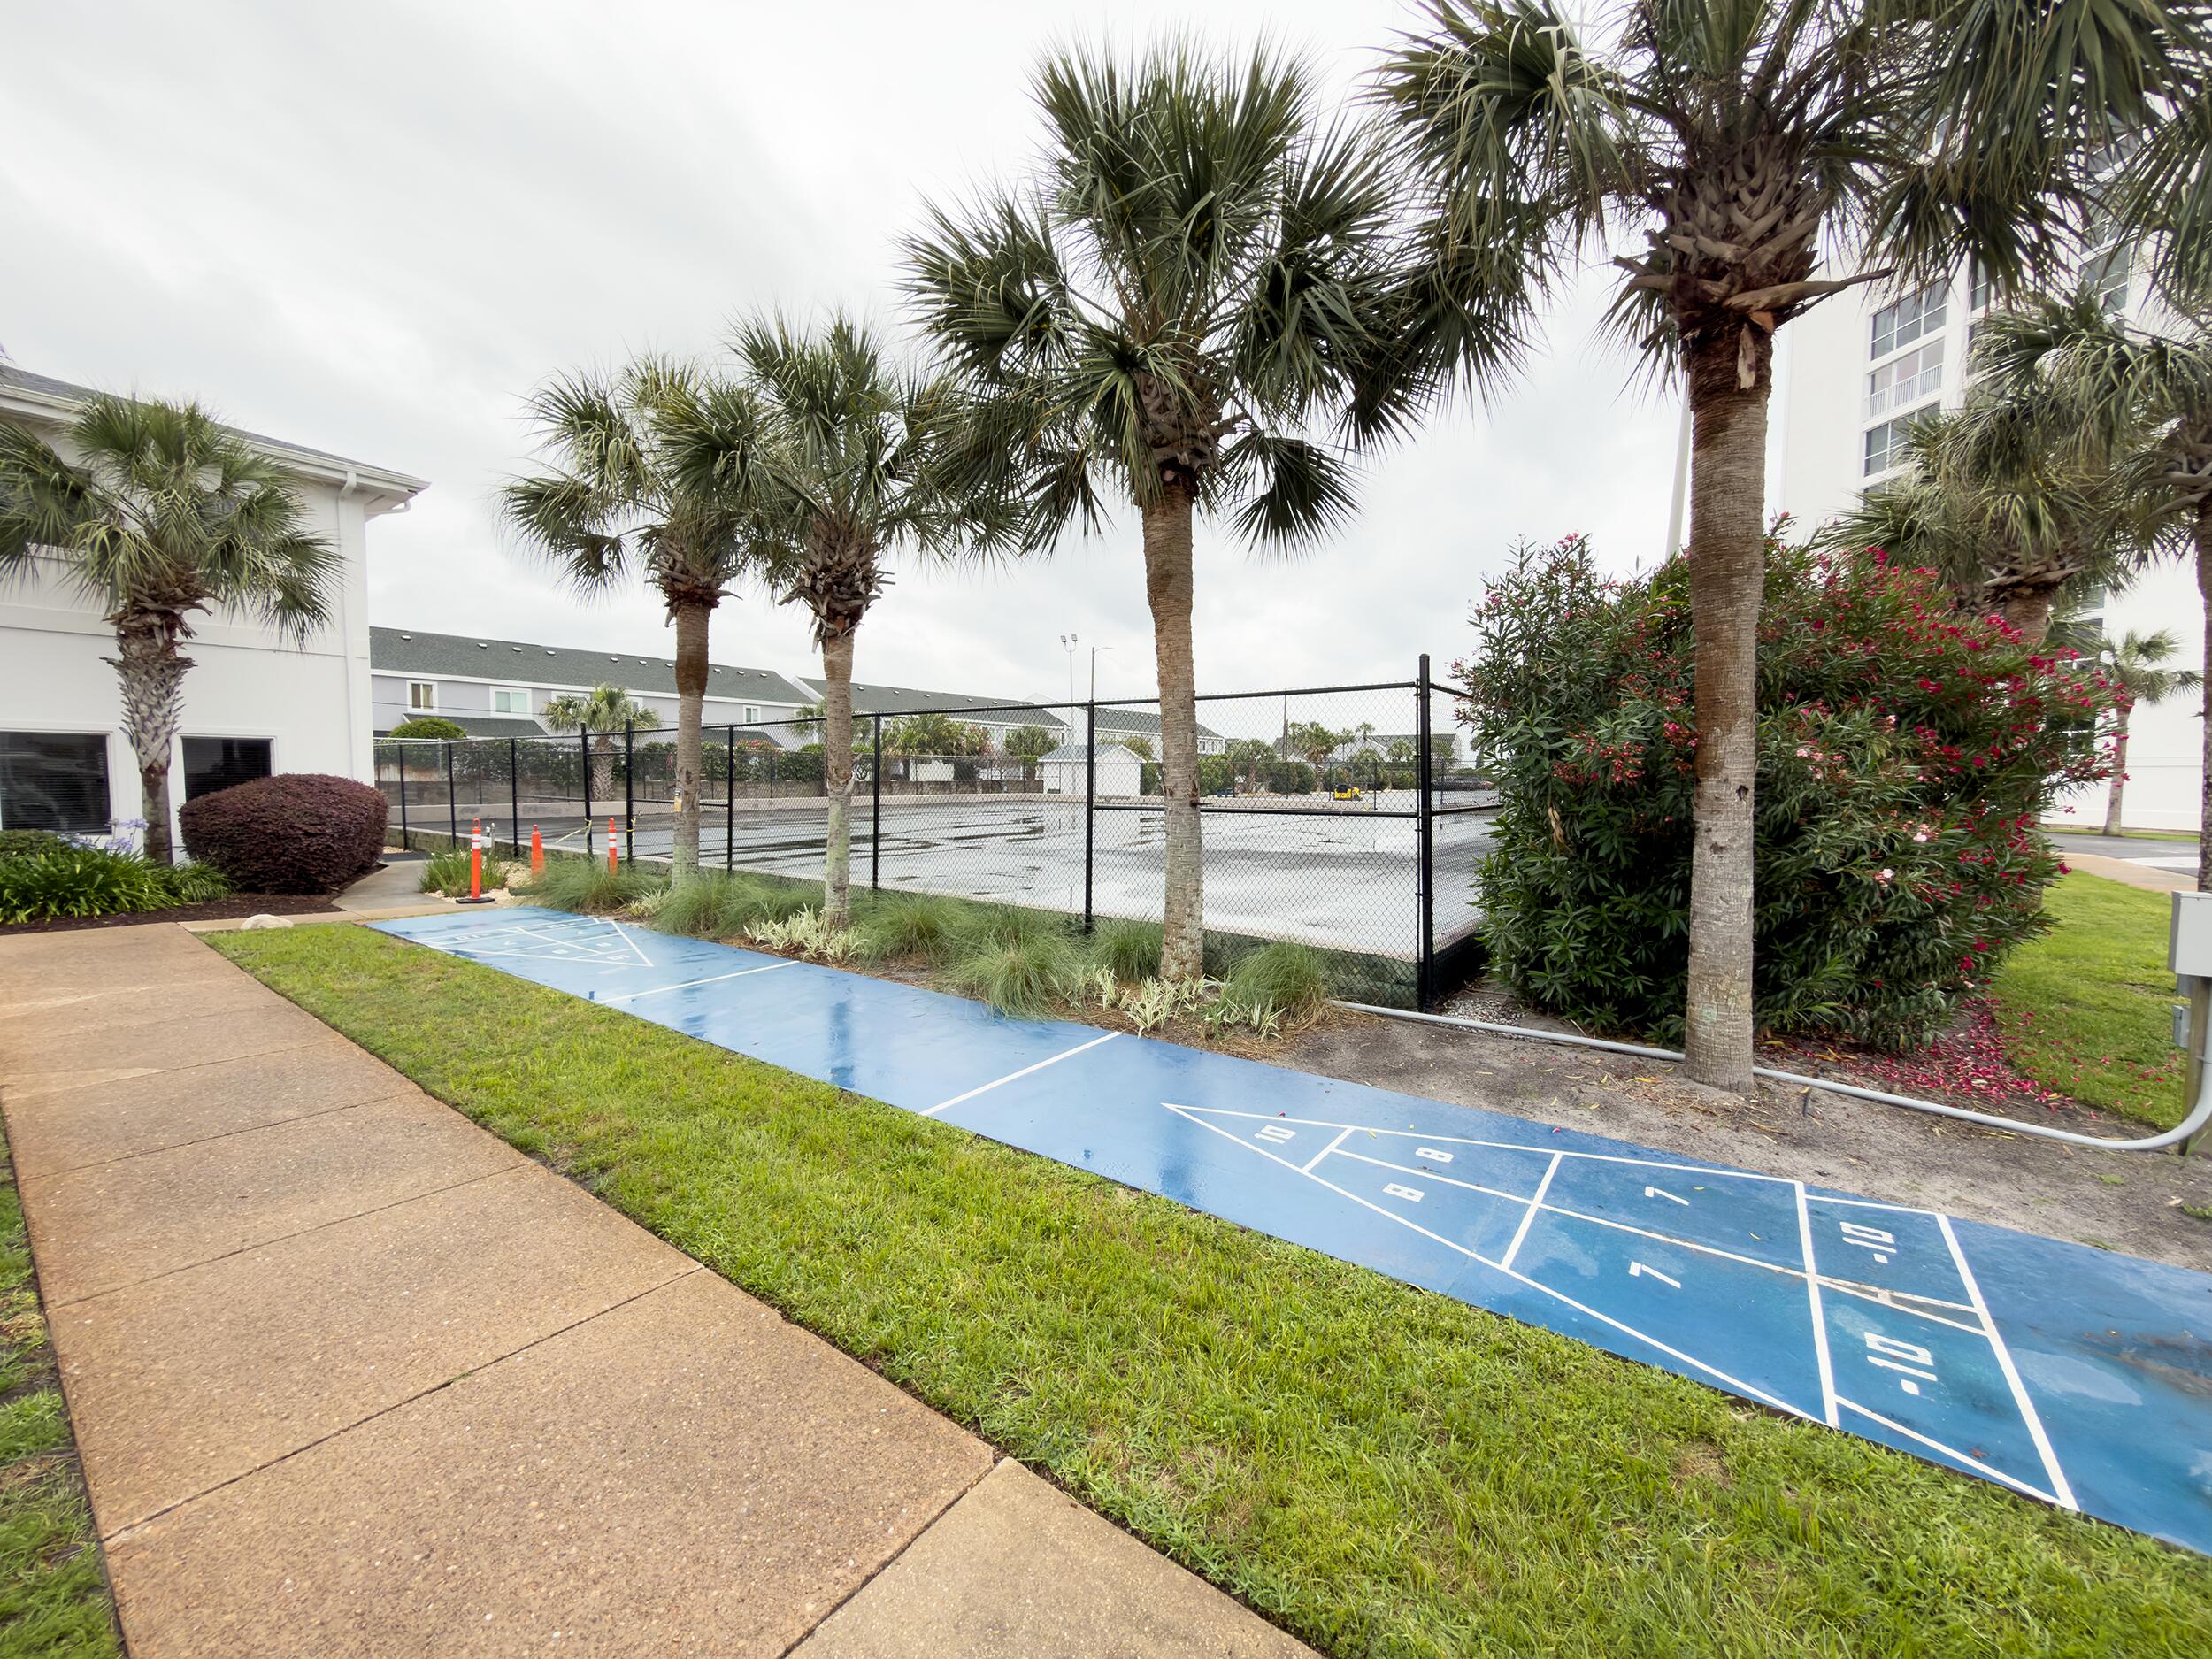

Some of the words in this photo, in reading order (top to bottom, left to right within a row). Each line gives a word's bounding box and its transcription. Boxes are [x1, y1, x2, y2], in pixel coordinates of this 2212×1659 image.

[1254, 1125, 1297, 1144] 10
[1415, 1147, 1455, 1164] 8
[1382, 1183, 1425, 1202] 8
[1644, 1186, 1690, 1206] 7
[1628, 1261, 1682, 1289] 7
